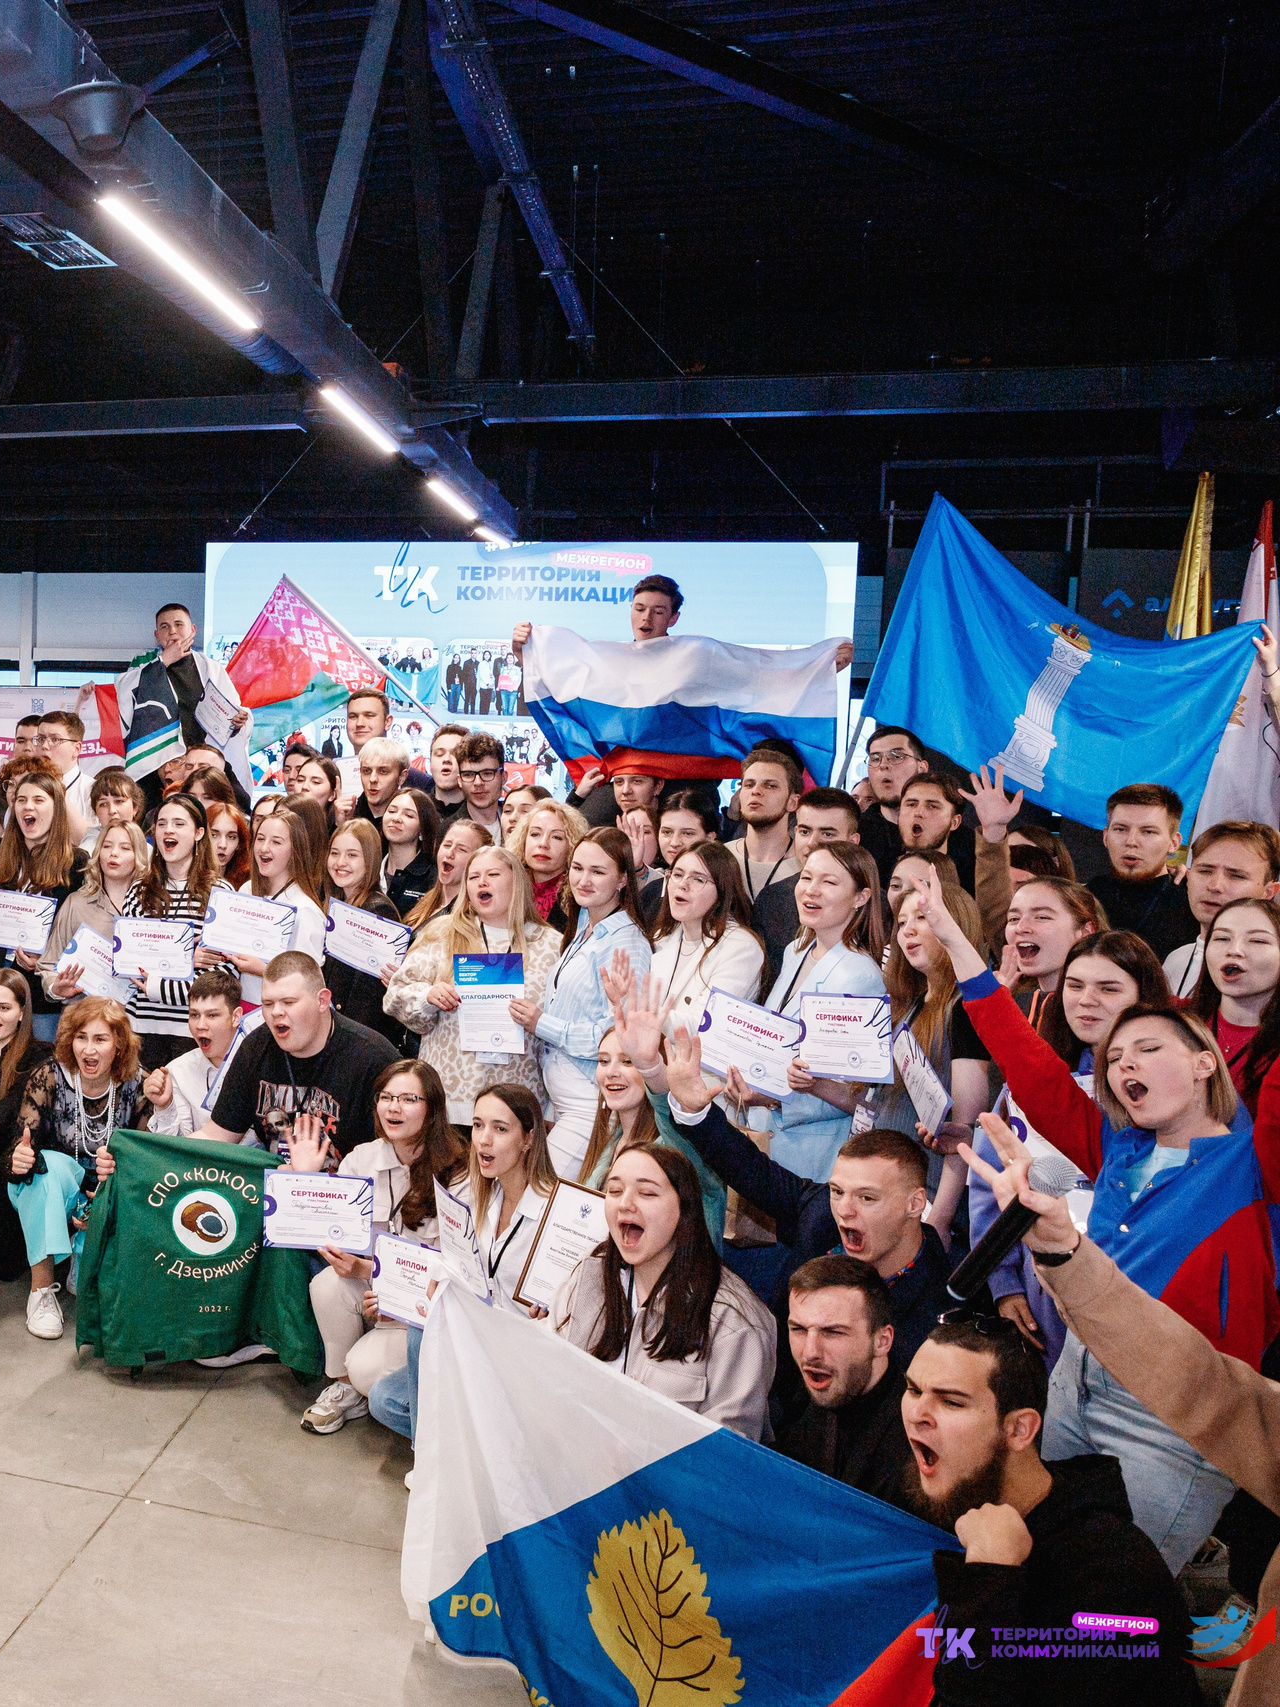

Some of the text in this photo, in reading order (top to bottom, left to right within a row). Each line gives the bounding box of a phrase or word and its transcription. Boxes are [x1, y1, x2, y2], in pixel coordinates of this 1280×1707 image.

[556, 552, 646, 570] МЕЖРЕГИОН
[457, 565, 600, 582] ТЕРРИТОРИЯ
[229, 906, 275, 922] СЕРТИФИКАТ
[131, 932, 175, 940] СЕРТИФИКАТ
[345, 919, 388, 940] СЕРТИФИКАТ
[90, 945, 113, 963] СЕРТИФ
[815, 1013, 863, 1022] СЕРТИФИКАТ
[727, 1014, 785, 1042] СЕРТИФИКАТ
[148, 1167, 260, 1207] СПО «КОКОС»
[290, 1190, 348, 1200] СЕРТИФИКАТ
[154, 1242, 260, 1282] г. Дзержинск
[396, 1257, 427, 1272] ДИПЛОМ
